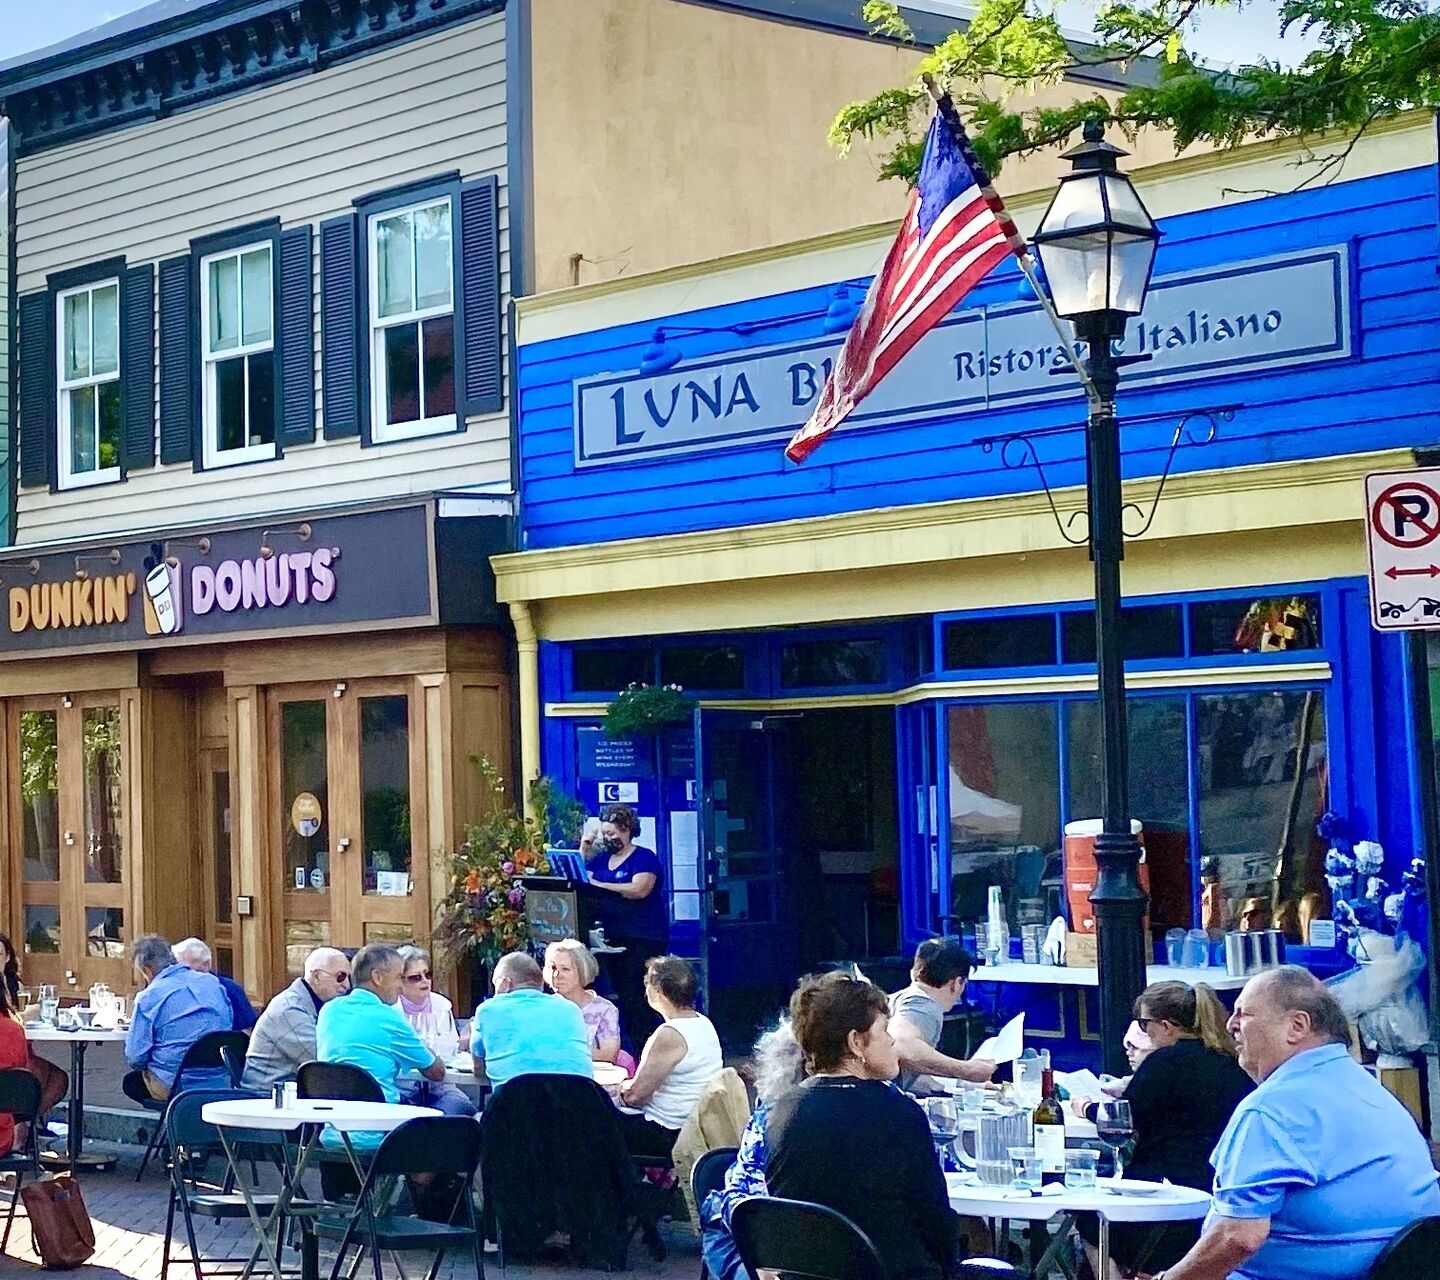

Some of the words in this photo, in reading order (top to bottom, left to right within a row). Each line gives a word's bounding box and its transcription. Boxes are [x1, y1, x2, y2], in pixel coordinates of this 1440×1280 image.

[953, 336, 1126, 382] Ristorae
[1136, 309, 1283, 354] Italiano
[610, 371, 761, 447] LUNA
[8, 570, 137, 634] DUNKIN'
[190, 547, 337, 616] DONUTS
